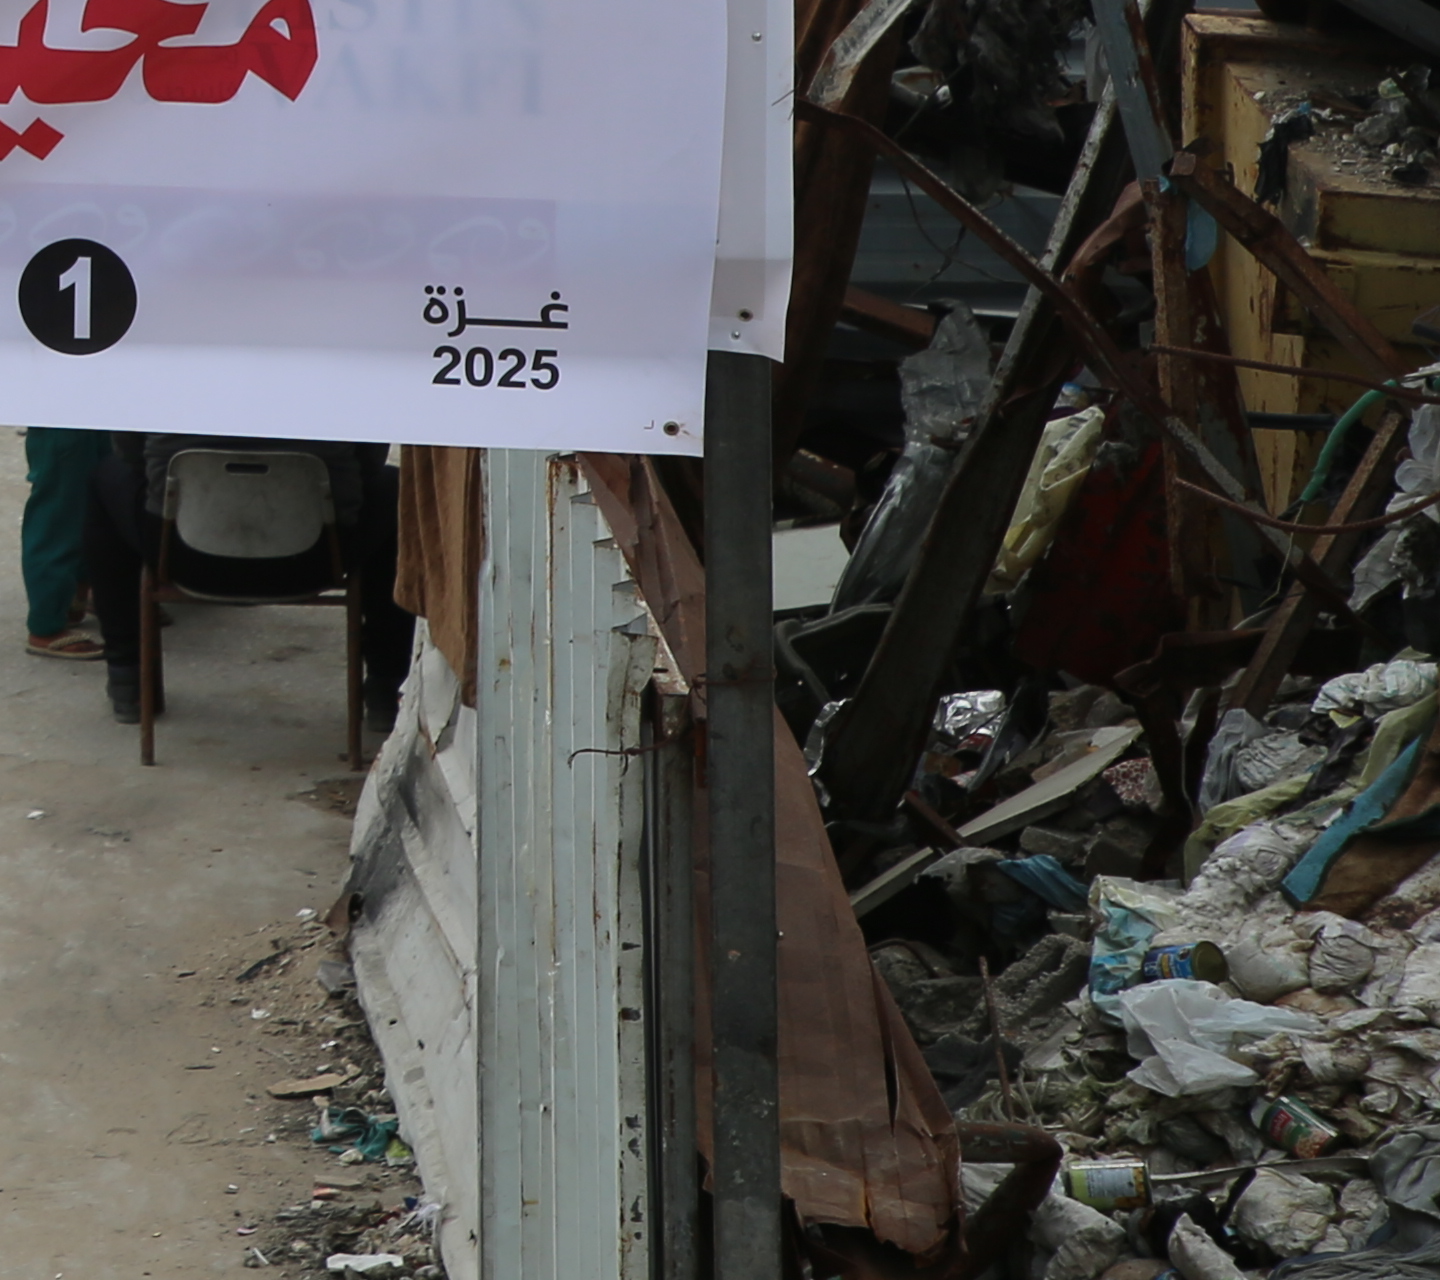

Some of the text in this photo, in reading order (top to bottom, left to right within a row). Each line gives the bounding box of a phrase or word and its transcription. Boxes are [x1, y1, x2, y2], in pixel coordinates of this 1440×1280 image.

[59, 256, 92, 339] 1
[423, 284, 569, 338] غزة
[432, 345, 561, 391] 2025
